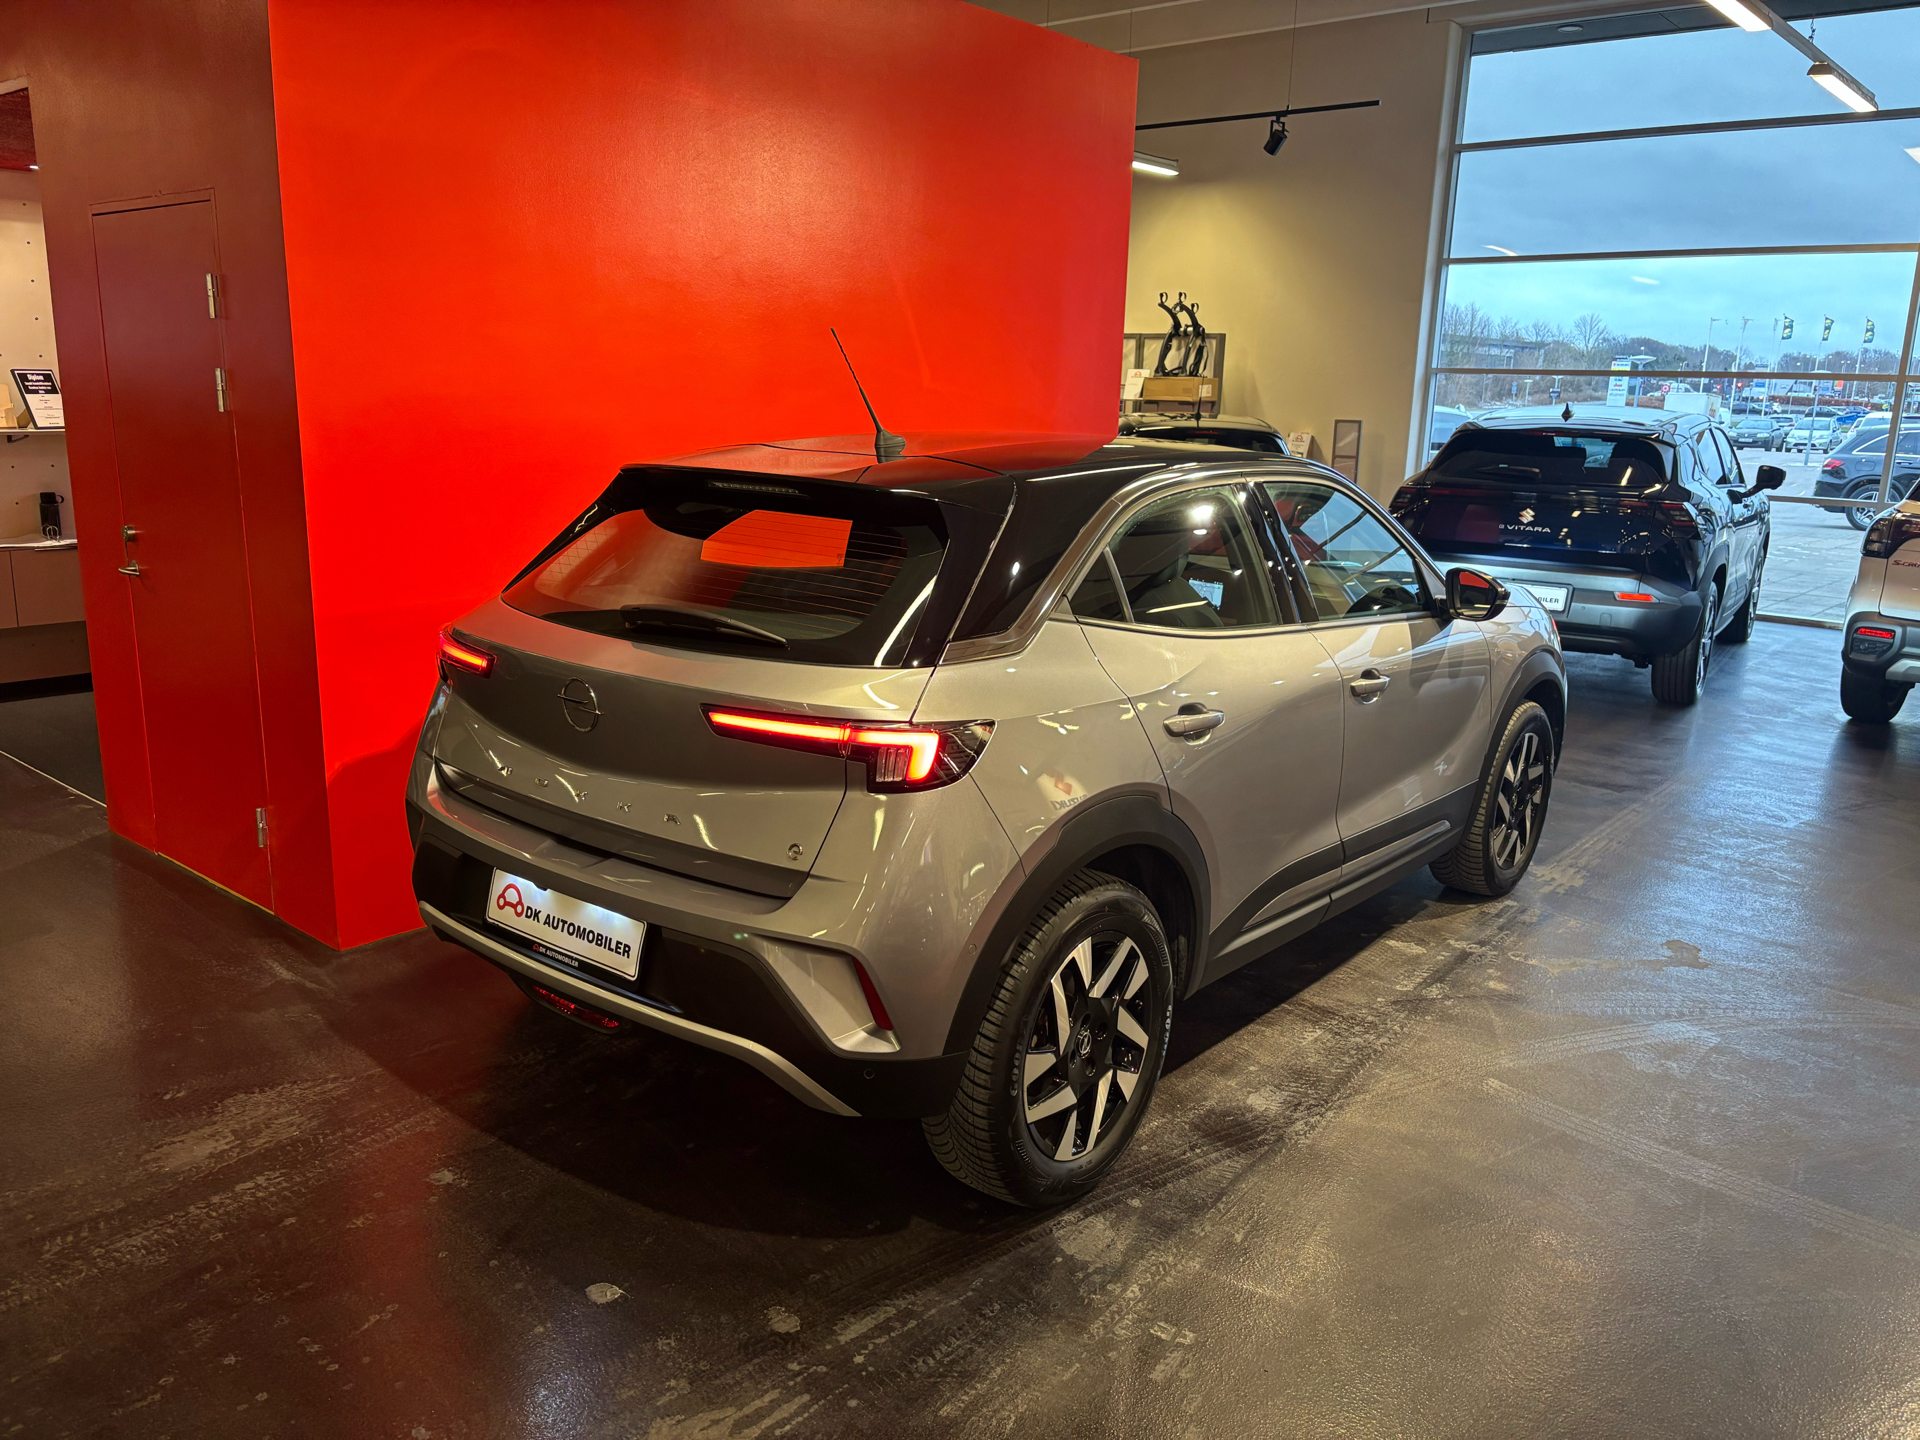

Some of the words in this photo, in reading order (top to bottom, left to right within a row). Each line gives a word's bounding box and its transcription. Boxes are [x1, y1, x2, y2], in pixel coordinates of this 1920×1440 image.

[1506, 524, 1551, 533] VITARA
[524, 905, 542, 924] DK
[542, 913, 632, 960] AUTOMOBILER
[539, 946, 546, 954] DK
[546, 949, 579, 968] AUTOMOBILER
